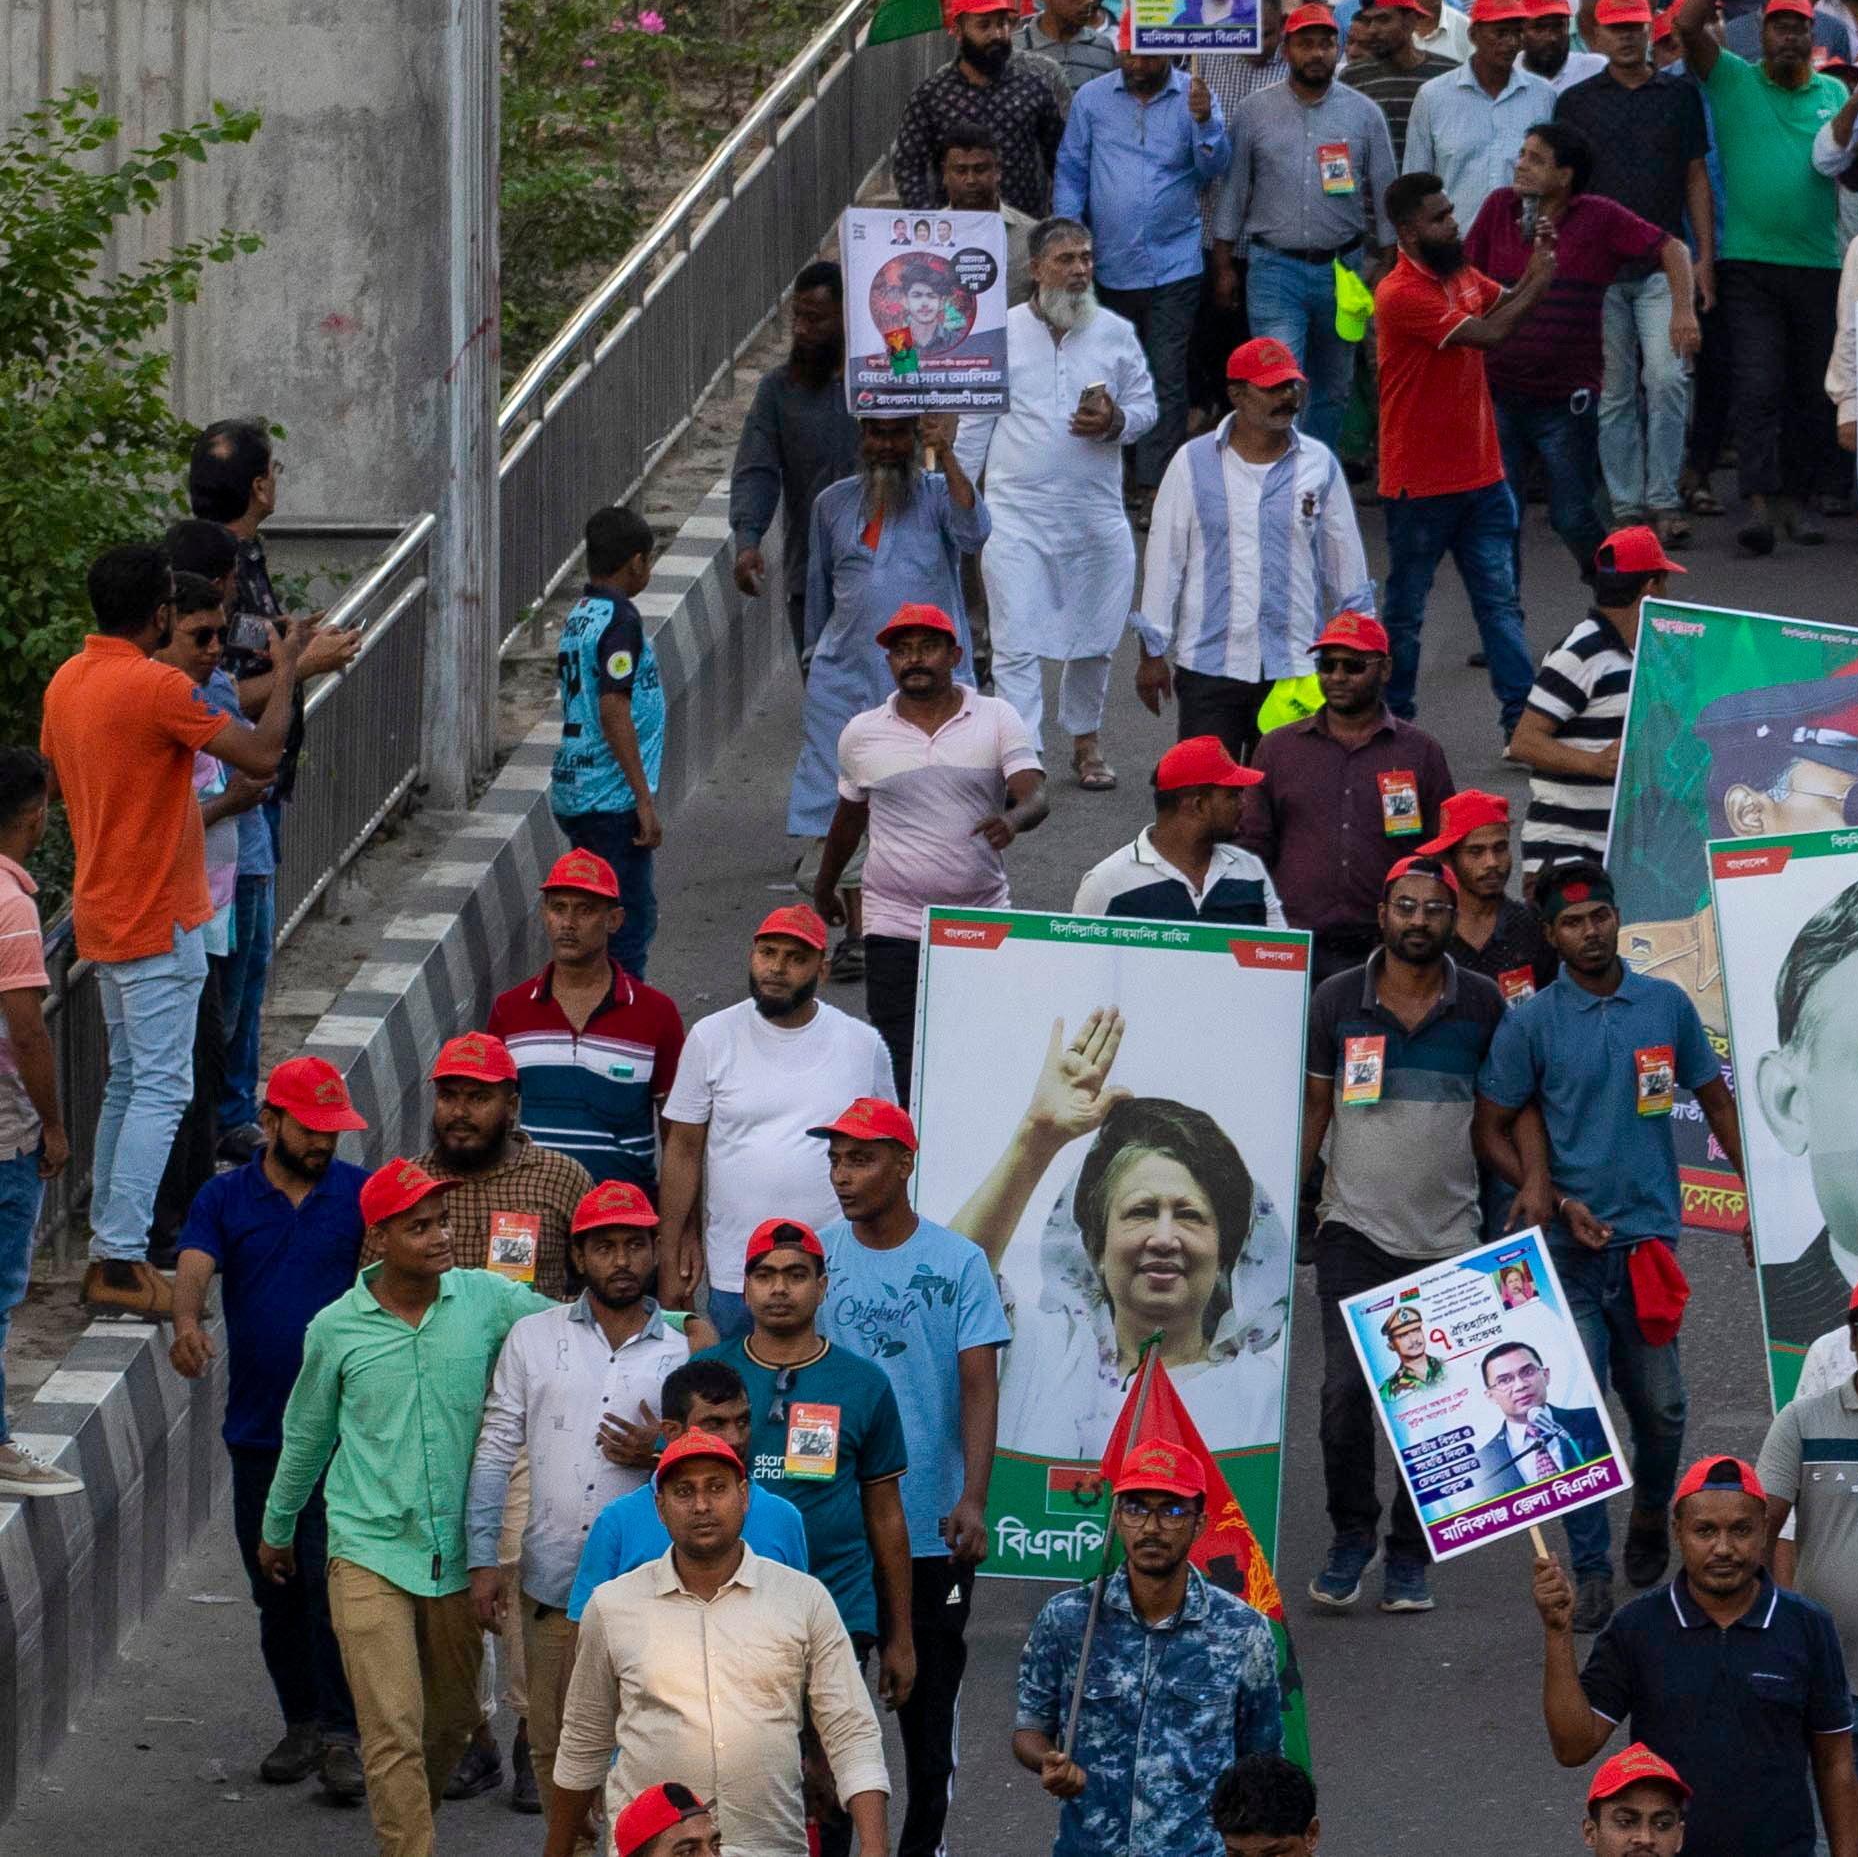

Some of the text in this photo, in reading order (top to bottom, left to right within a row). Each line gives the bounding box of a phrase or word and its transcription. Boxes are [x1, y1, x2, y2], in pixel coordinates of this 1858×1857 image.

[1727, 855, 1769, 871] বাংলাদেশ
[944, 927, 986, 942] বাংলাদেশ
[1161, 928, 1190, 944] রাহিম
[1256, 947, 1293, 962] জিন্দাবাদ
[1430, 1328, 1452, 1350] ৭
[1438, 1464, 1611, 1544] মানিকগঞ্জ জেলা বিএনপি
